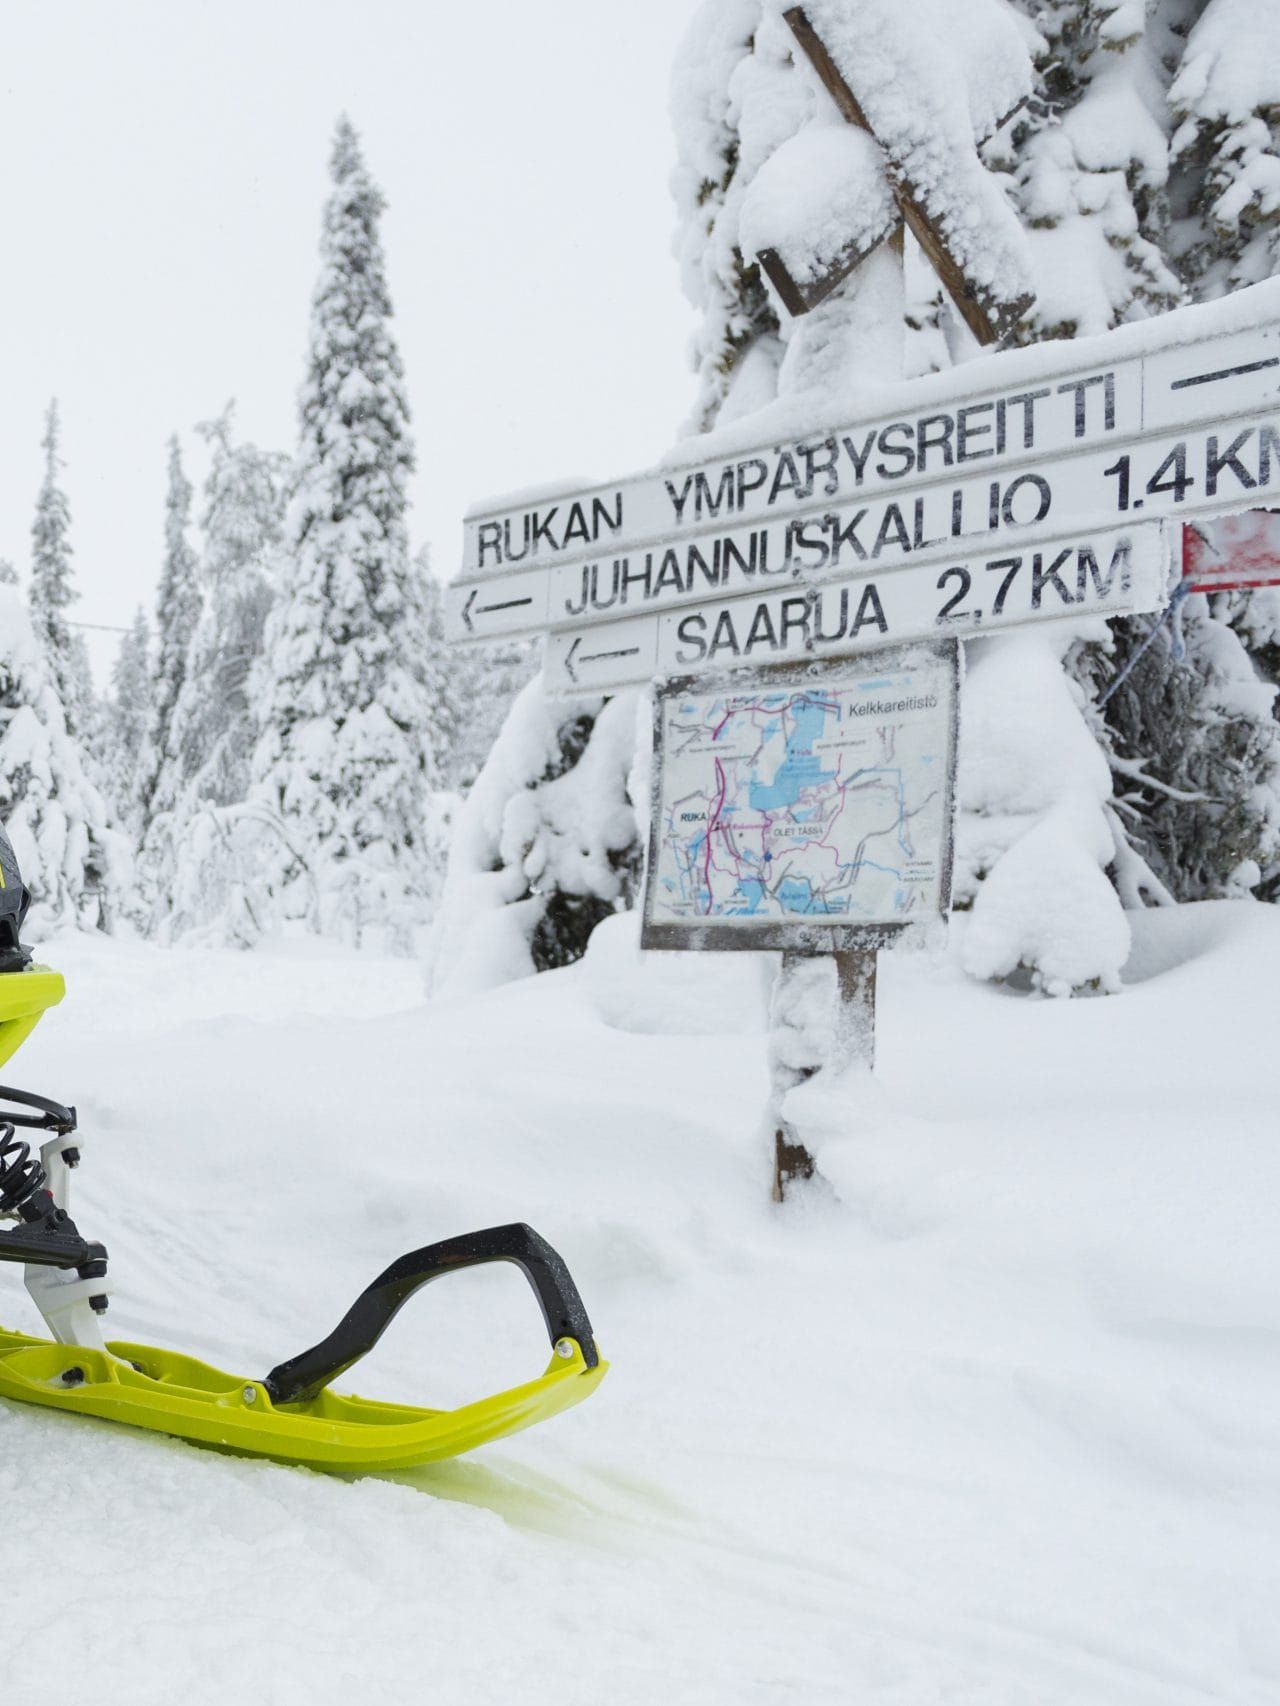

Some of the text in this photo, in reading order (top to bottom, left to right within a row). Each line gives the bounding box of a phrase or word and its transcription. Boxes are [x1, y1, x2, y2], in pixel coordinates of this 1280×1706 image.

[478, 373, 1115, 568] RUKAN YMPÄRYSREITTI
[565, 473, 1052, 615] JUHANNUSKALLIO
[676, 583, 888, 664] SAARUA
[849, 695, 938, 717] Kelkkareitistö
[680, 812, 707, 822] RUKA
